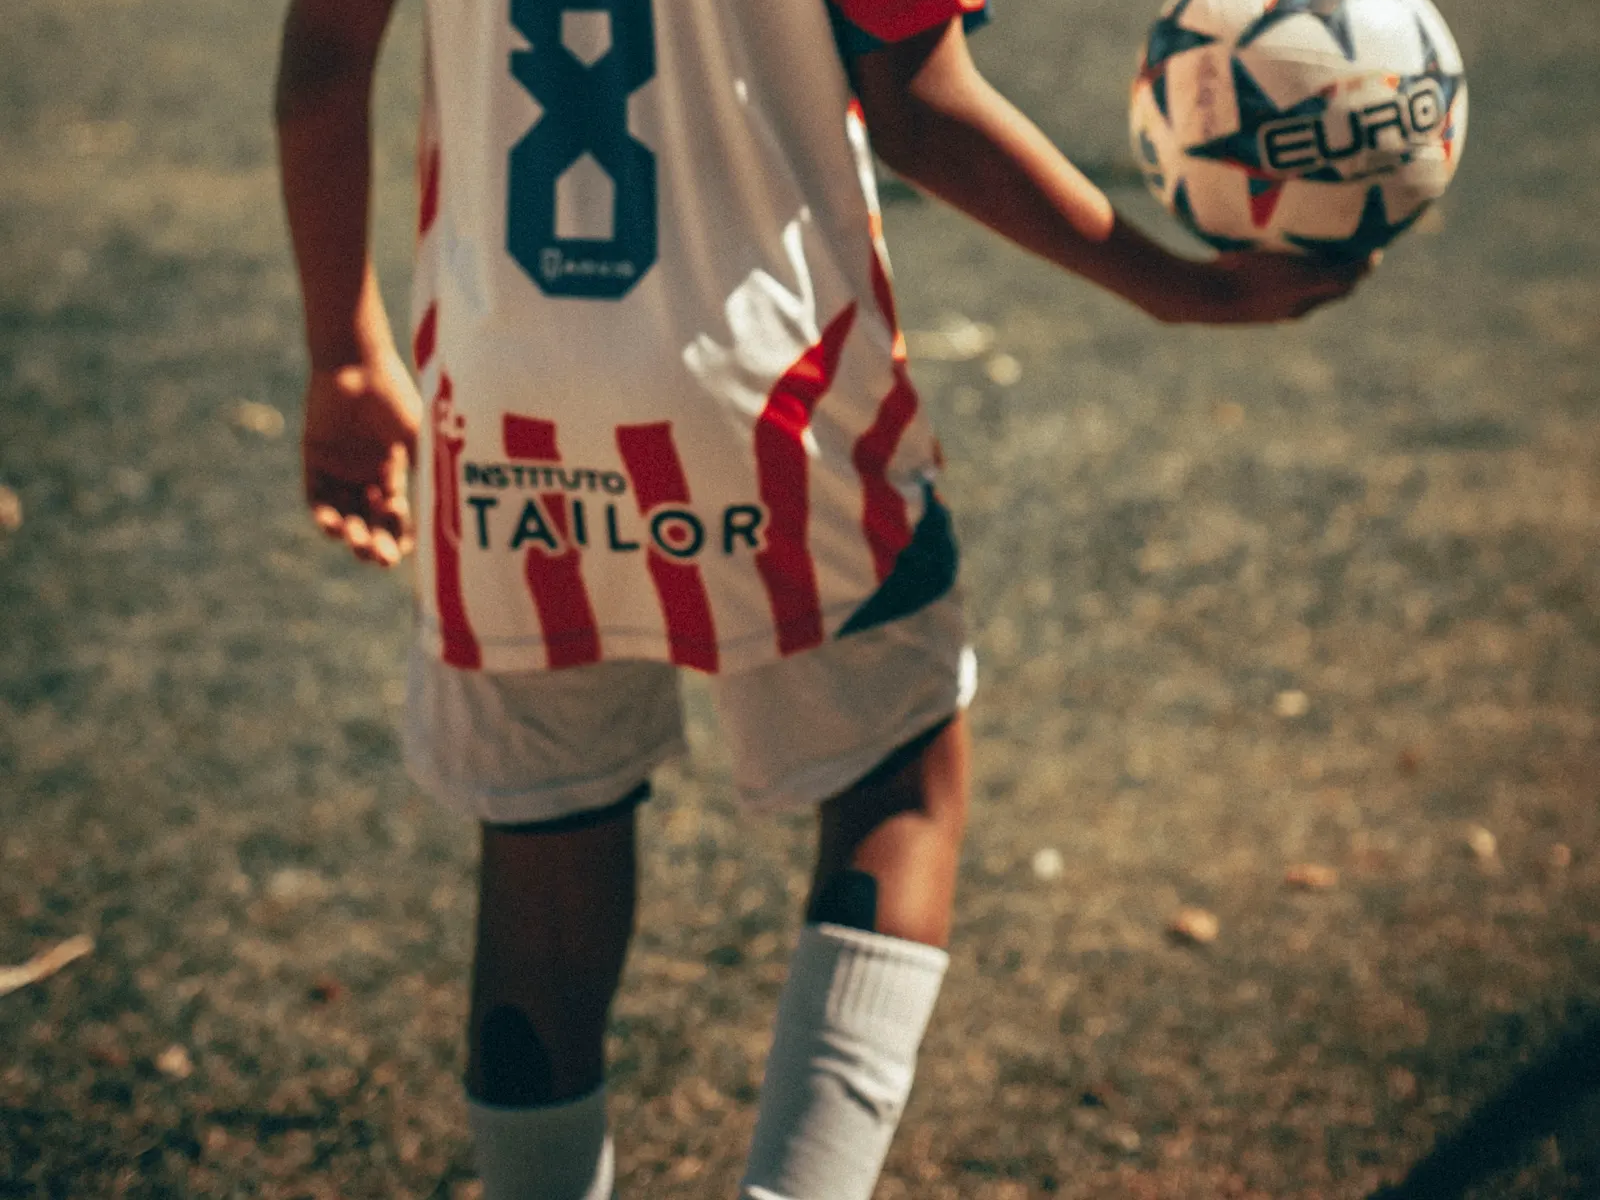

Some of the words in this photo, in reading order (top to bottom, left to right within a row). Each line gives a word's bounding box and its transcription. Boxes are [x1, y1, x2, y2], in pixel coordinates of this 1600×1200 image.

[1264, 88, 1441, 170] EURO
[464, 463, 626, 495] INSTITUTO
[466, 497, 763, 558] TAILOR
